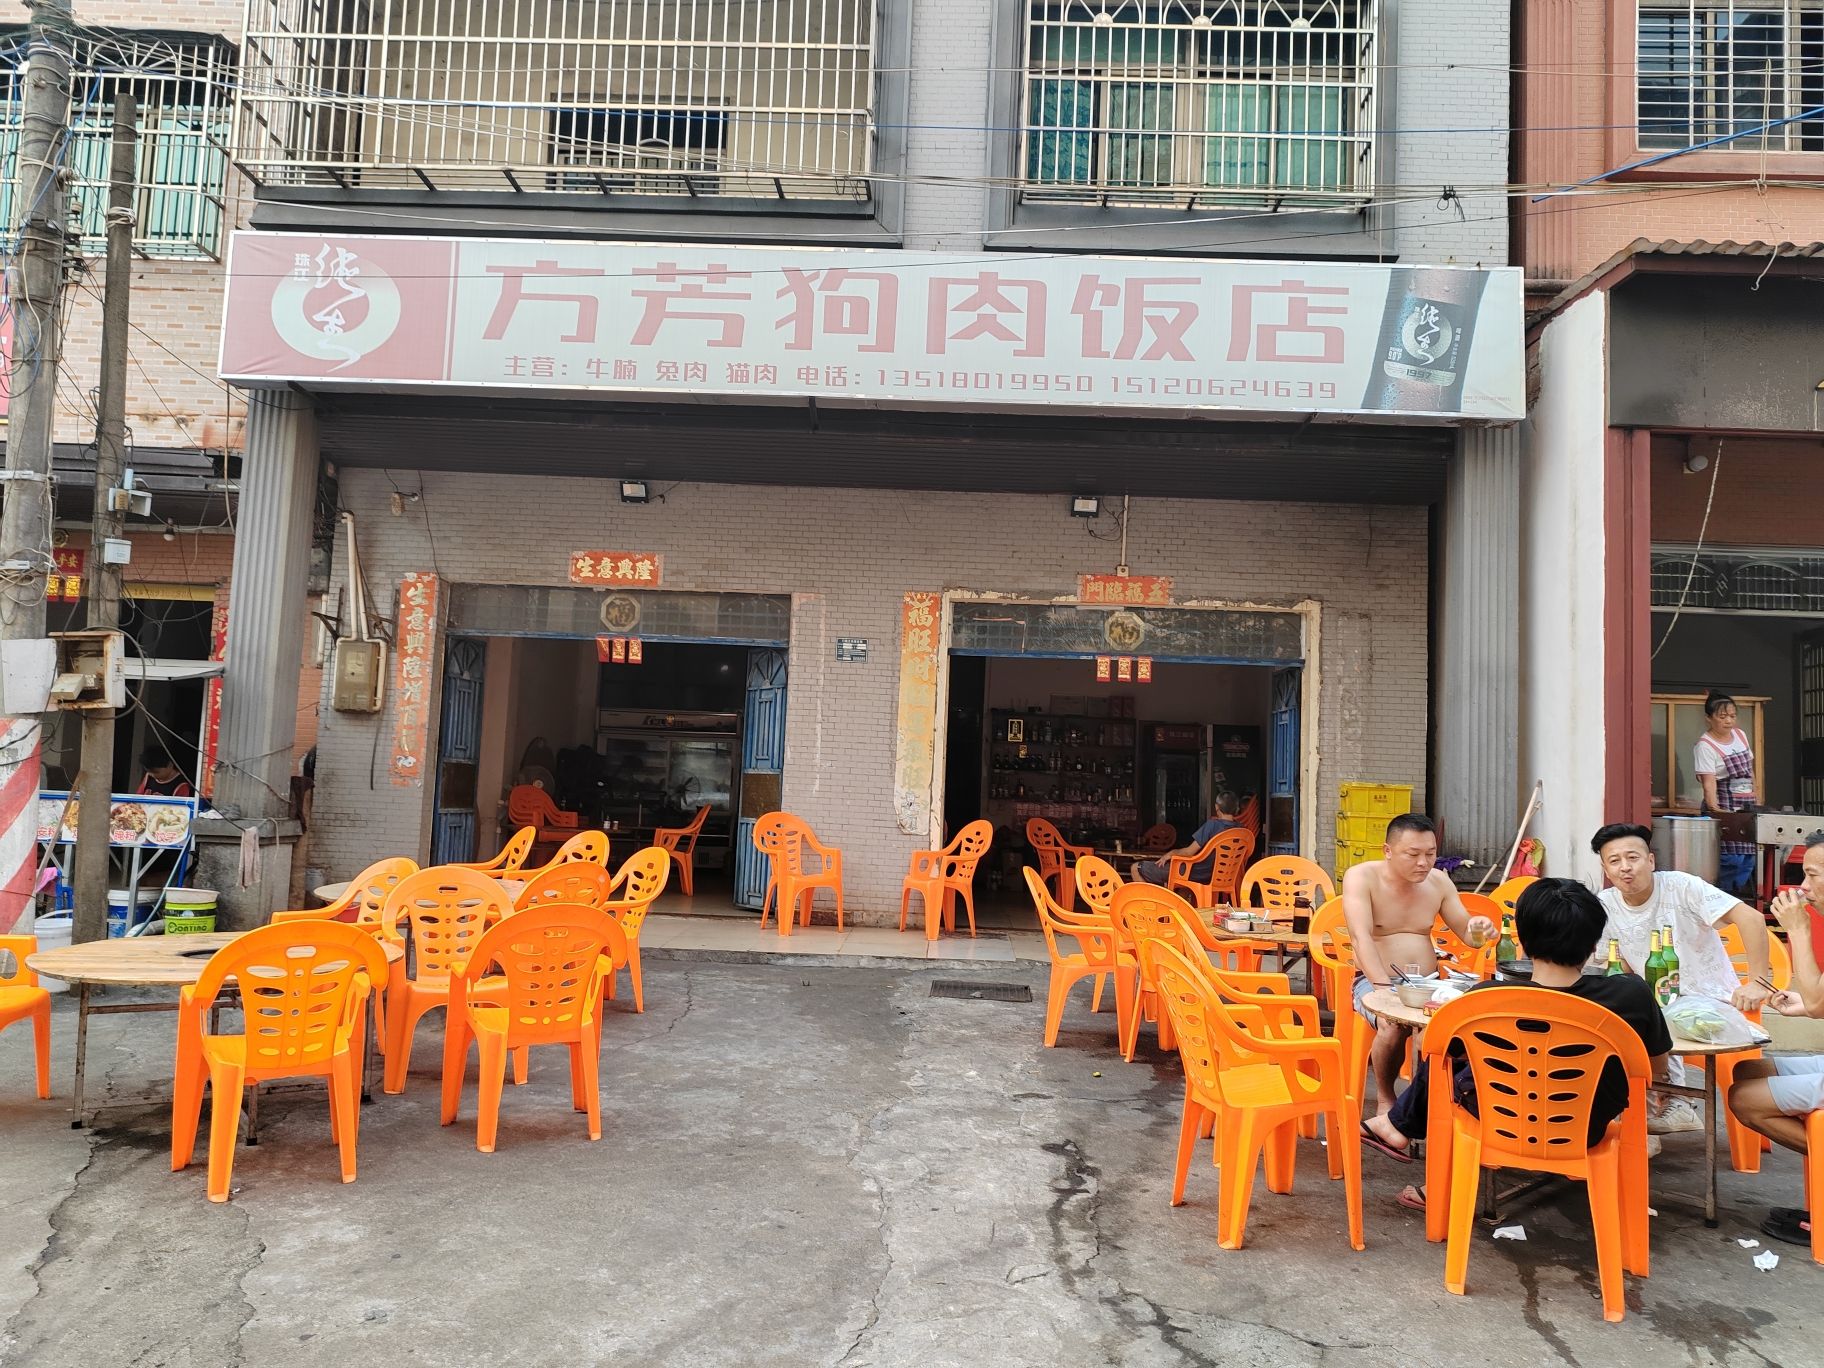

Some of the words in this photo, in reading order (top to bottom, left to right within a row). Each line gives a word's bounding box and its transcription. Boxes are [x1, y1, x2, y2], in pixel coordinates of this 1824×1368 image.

[482, 260, 1349, 364] 方芳狗肉饭店
[656, 360, 707, 383] 兔肉
[726, 362, 777, 385] 猫肉
[1111, 377, 1336, 398] 15120624639
[1406, 369, 1432, 379] 1997
